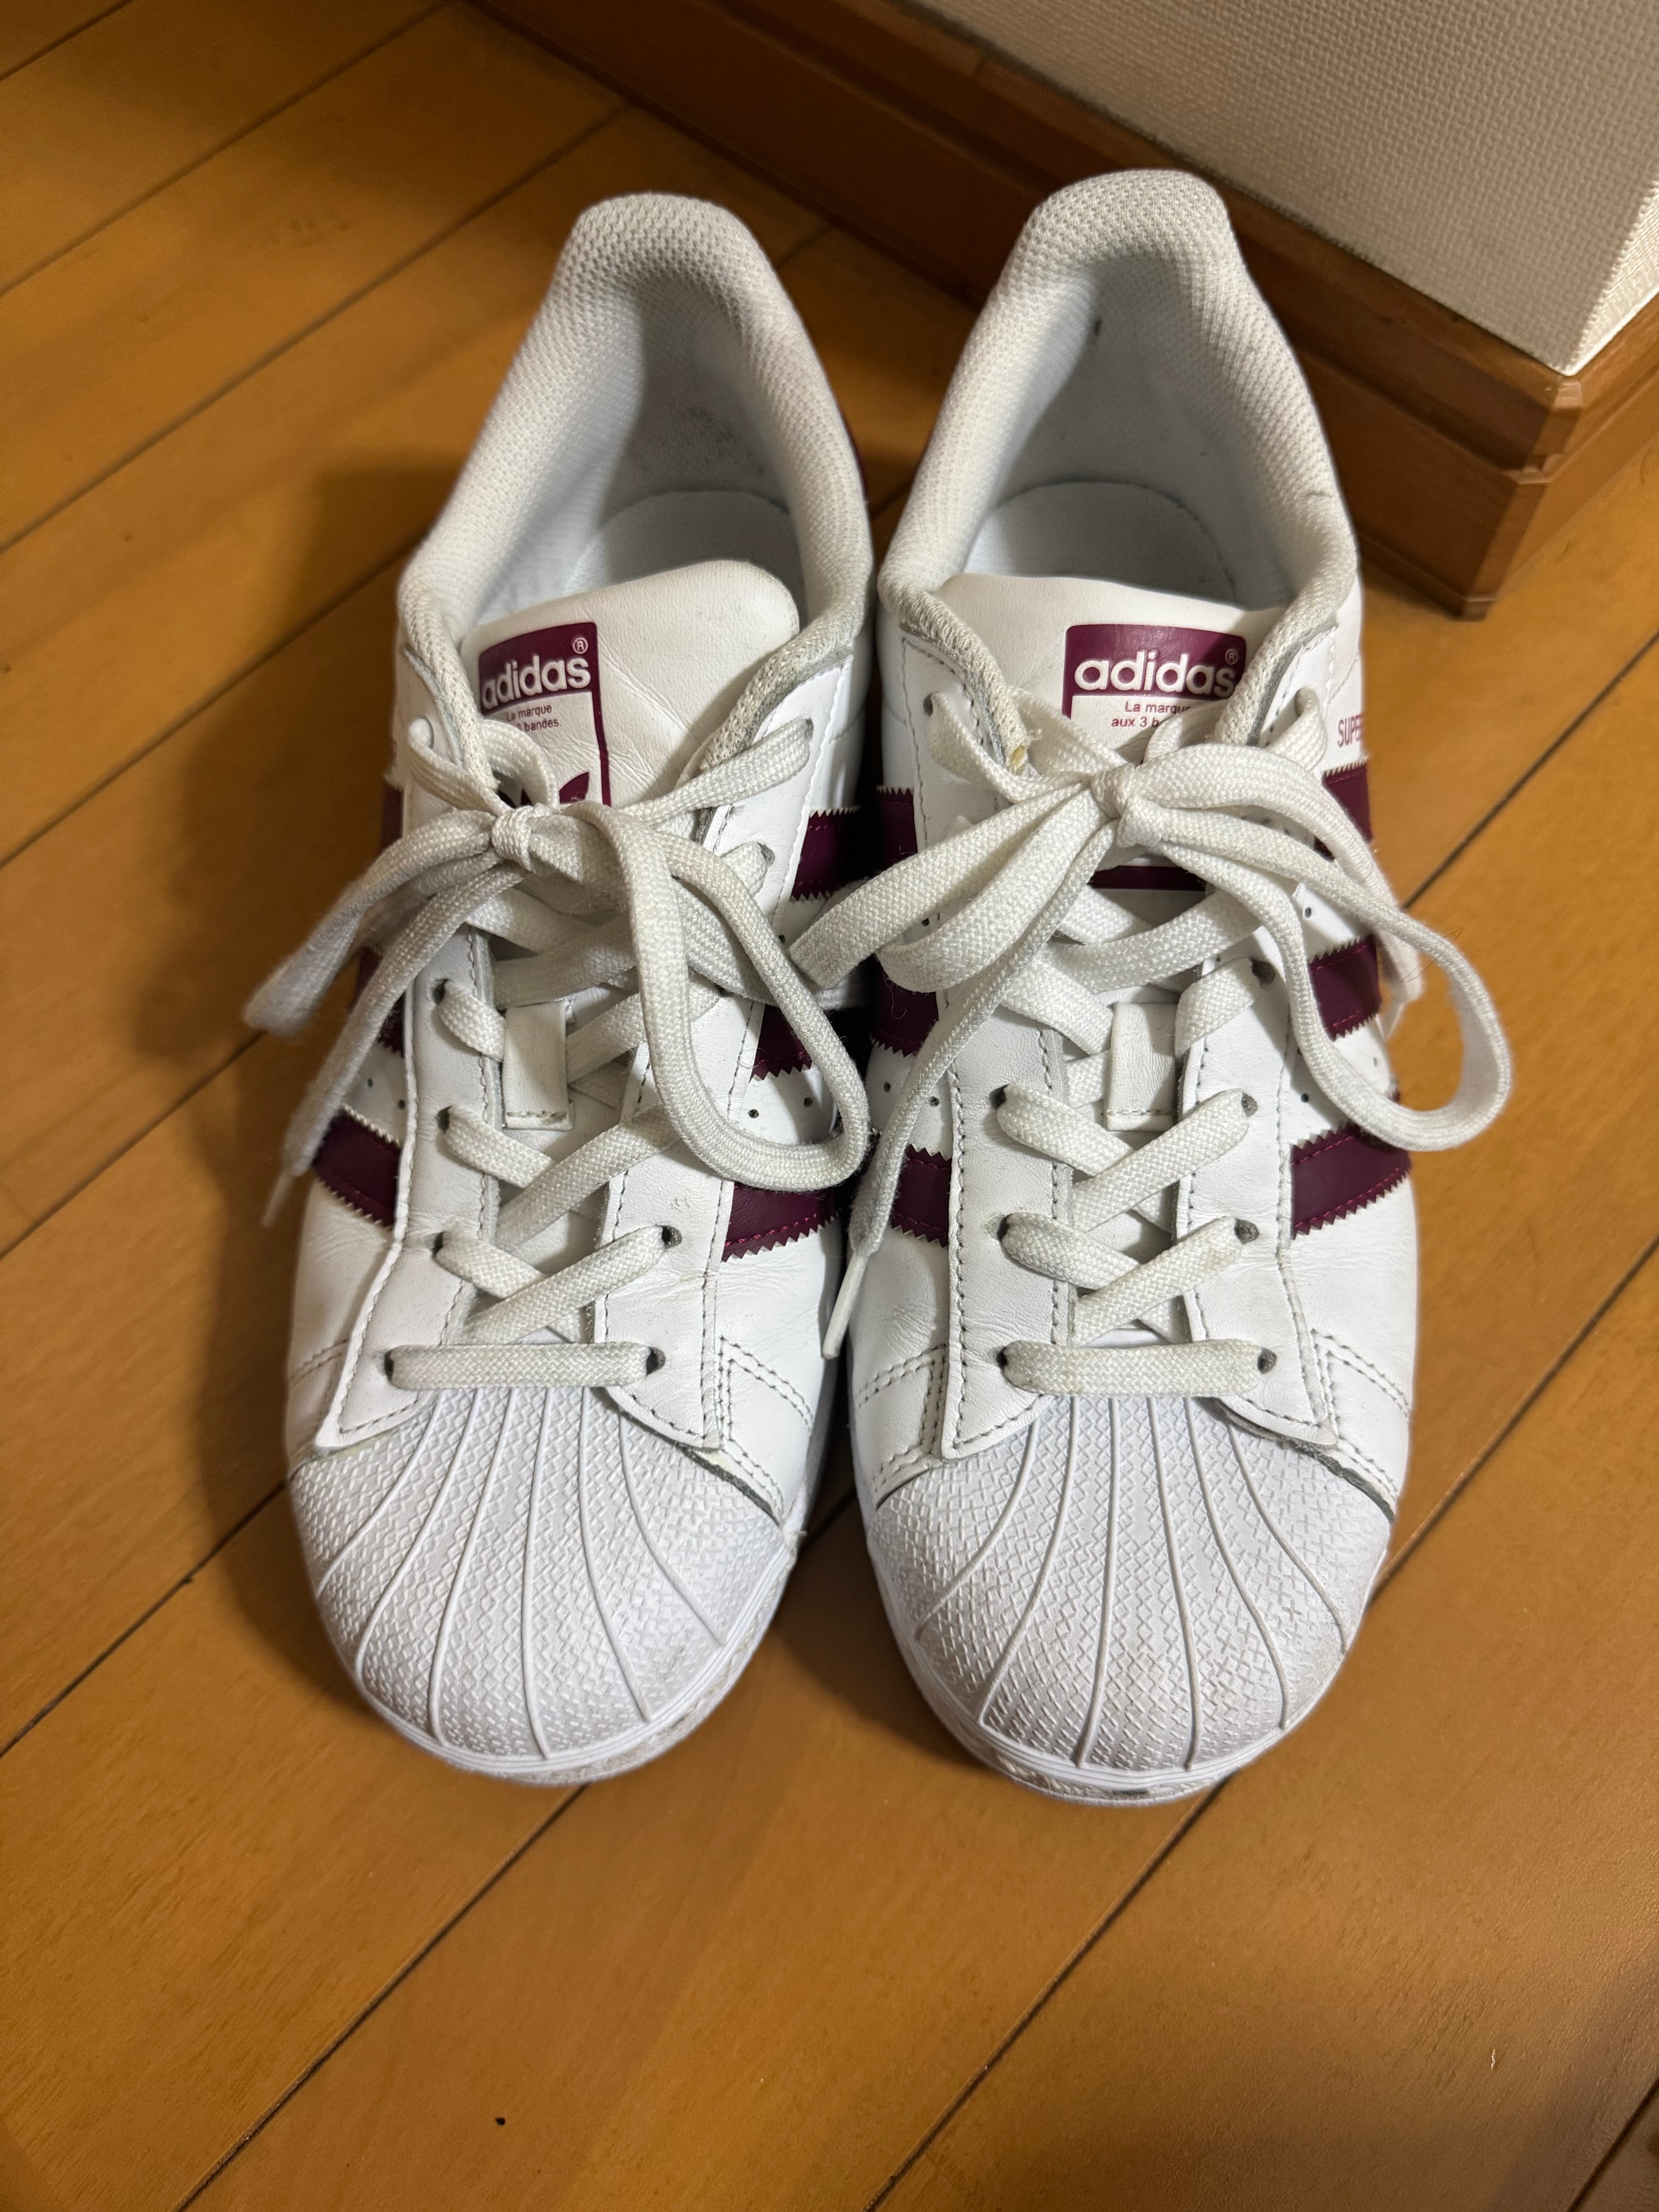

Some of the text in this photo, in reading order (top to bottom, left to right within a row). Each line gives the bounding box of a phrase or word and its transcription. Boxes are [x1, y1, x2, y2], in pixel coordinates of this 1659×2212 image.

[1074, 650, 1235, 697] adidas
[482, 655, 591, 709] adidas
[507, 705, 552, 721] La marque
[1125, 701, 1140, 712] La
[1111, 718, 1135, 727] aux
[1140, 717, 1147, 727] 3
